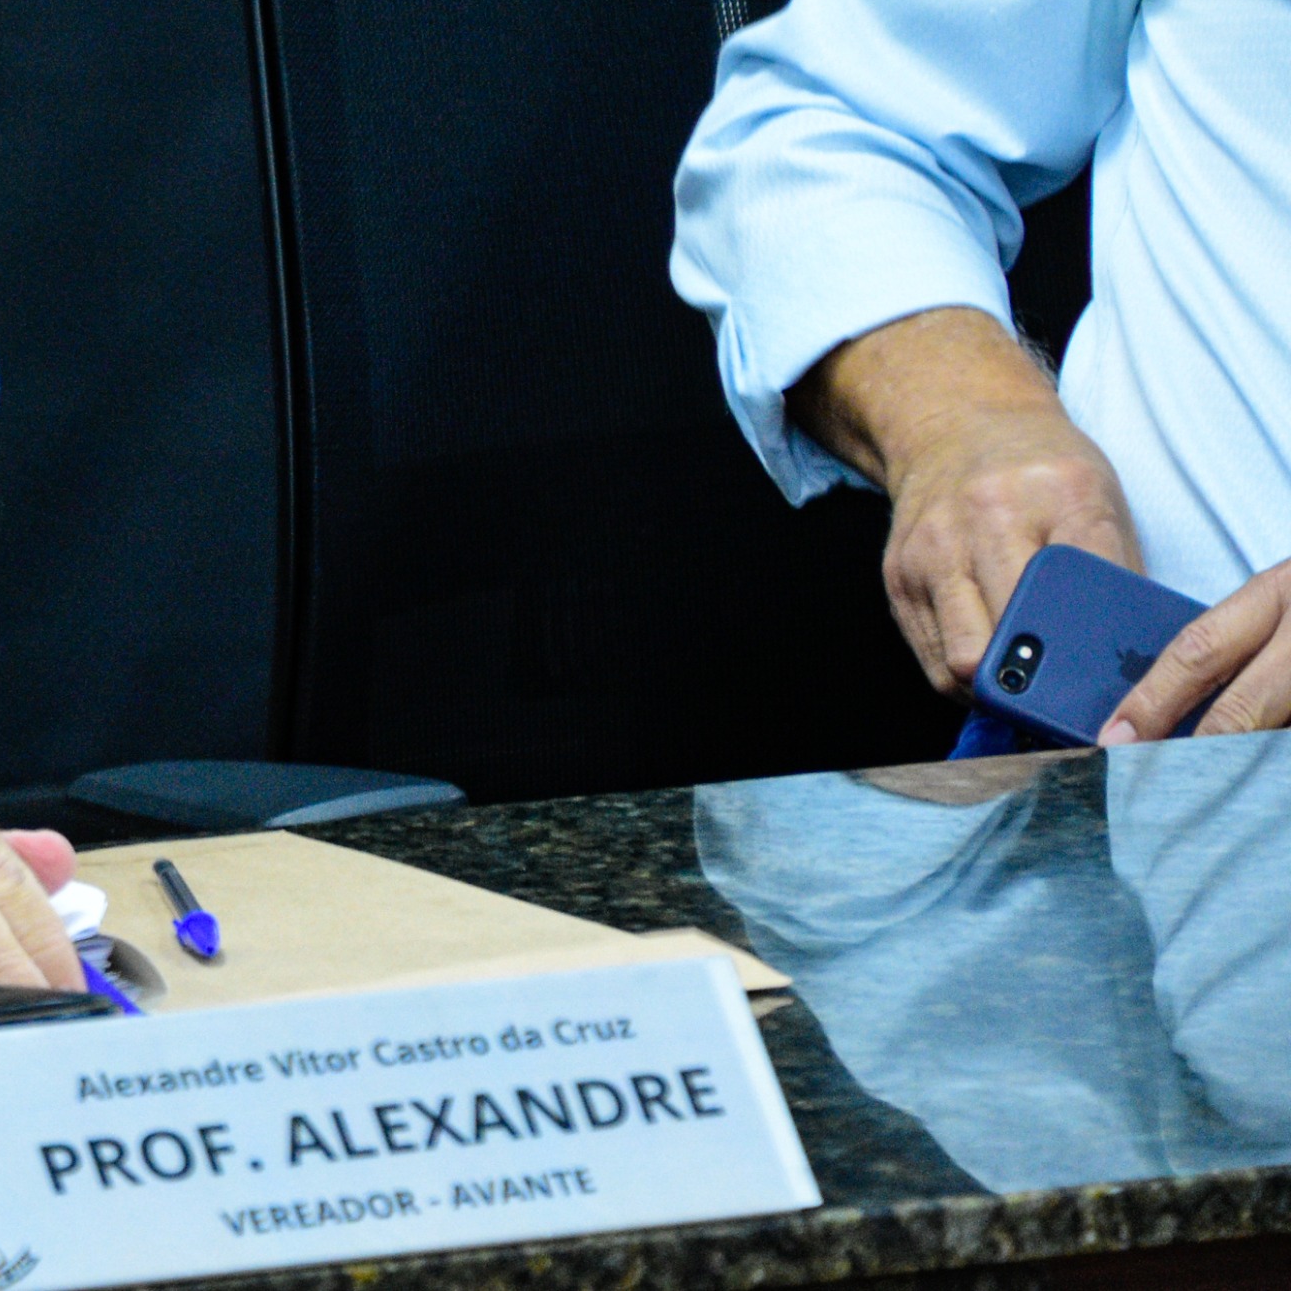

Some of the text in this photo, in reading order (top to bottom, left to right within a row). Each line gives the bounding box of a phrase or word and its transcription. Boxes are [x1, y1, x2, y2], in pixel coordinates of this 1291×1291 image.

[78, 1016, 637, 1102] Alexandre Vitor Castro da Cruz
[38, 1066, 726, 1196] PROF. ALEXANDRE
[220, 1187, 421, 1236] VEREADOR
[451, 1167, 598, 1212] AVANTE
